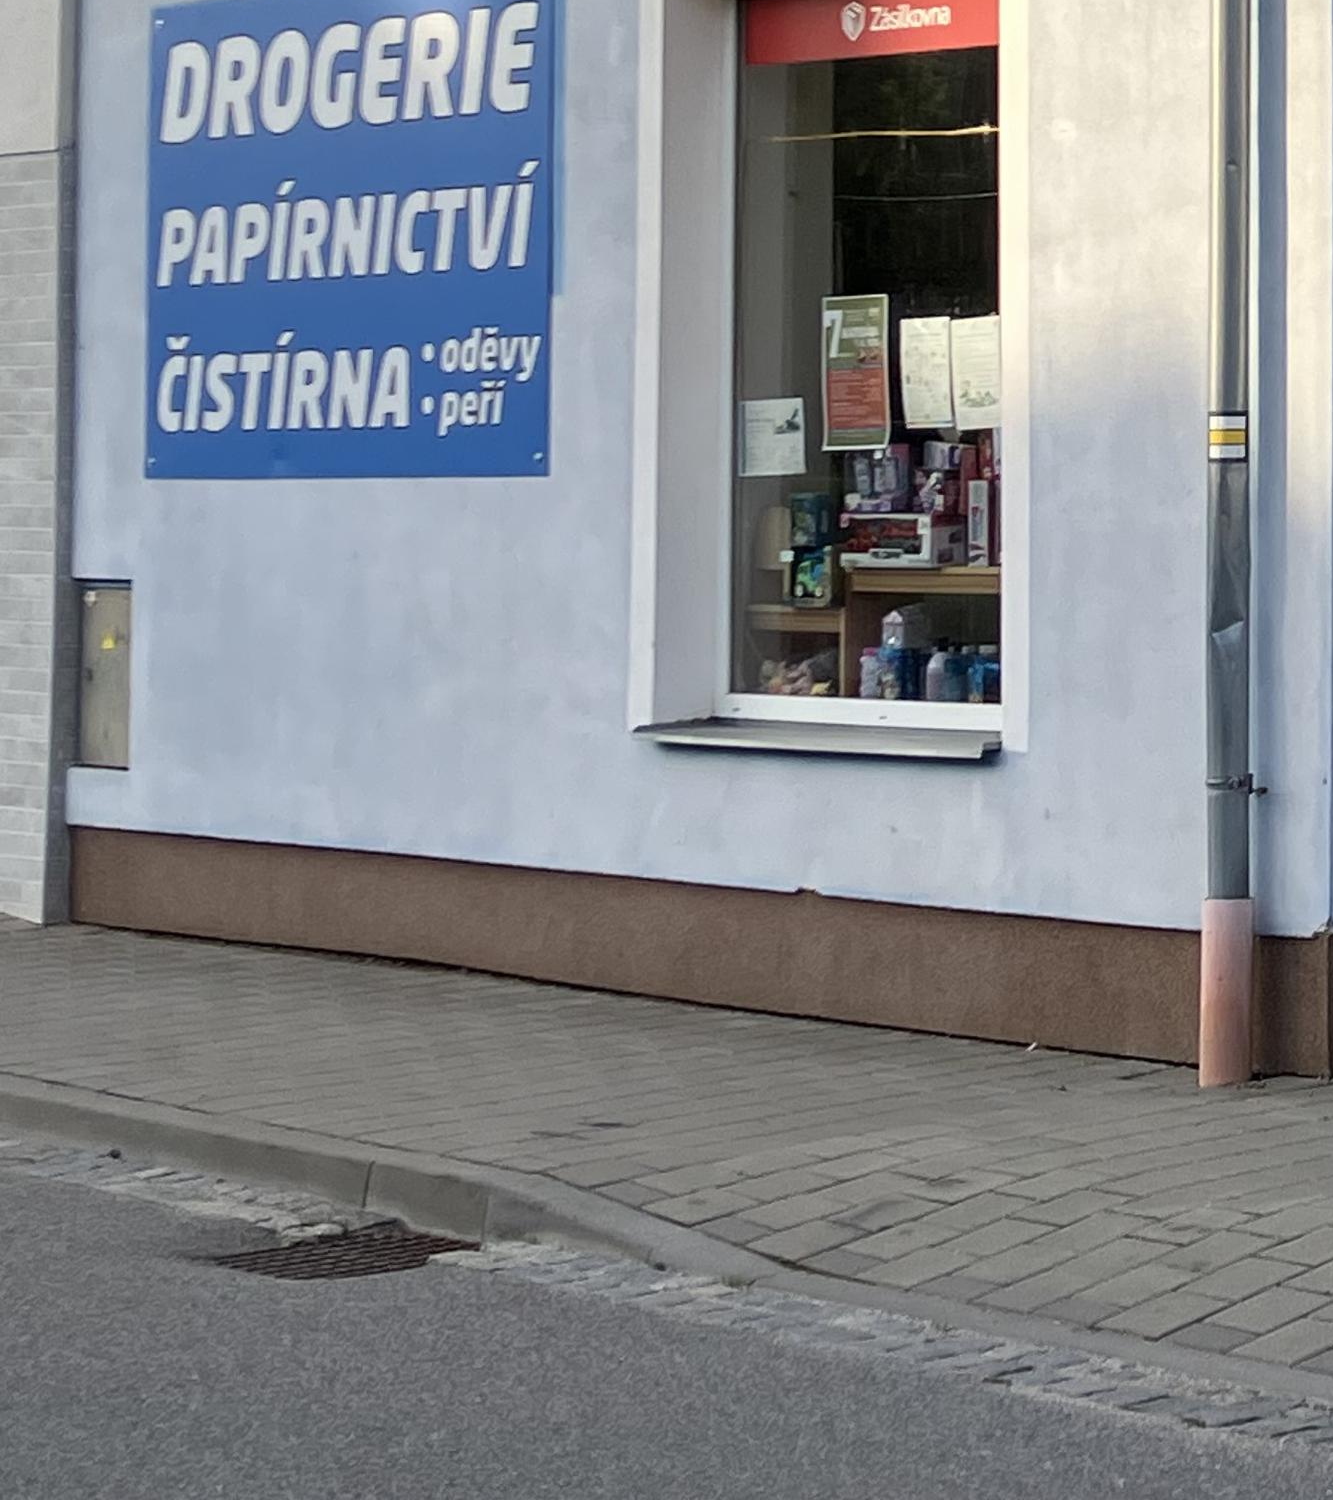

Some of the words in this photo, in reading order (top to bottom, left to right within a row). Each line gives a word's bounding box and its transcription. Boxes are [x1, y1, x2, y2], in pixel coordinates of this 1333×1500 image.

[160, 2, 538, 143] DROGERIE
[157, 161, 539, 287] PAPÍRNICTVÍ
[157, 331, 411, 432] ČISTÍRNA
[440, 327, 541, 380] oděvy
[438, 382, 505, 435] peří
